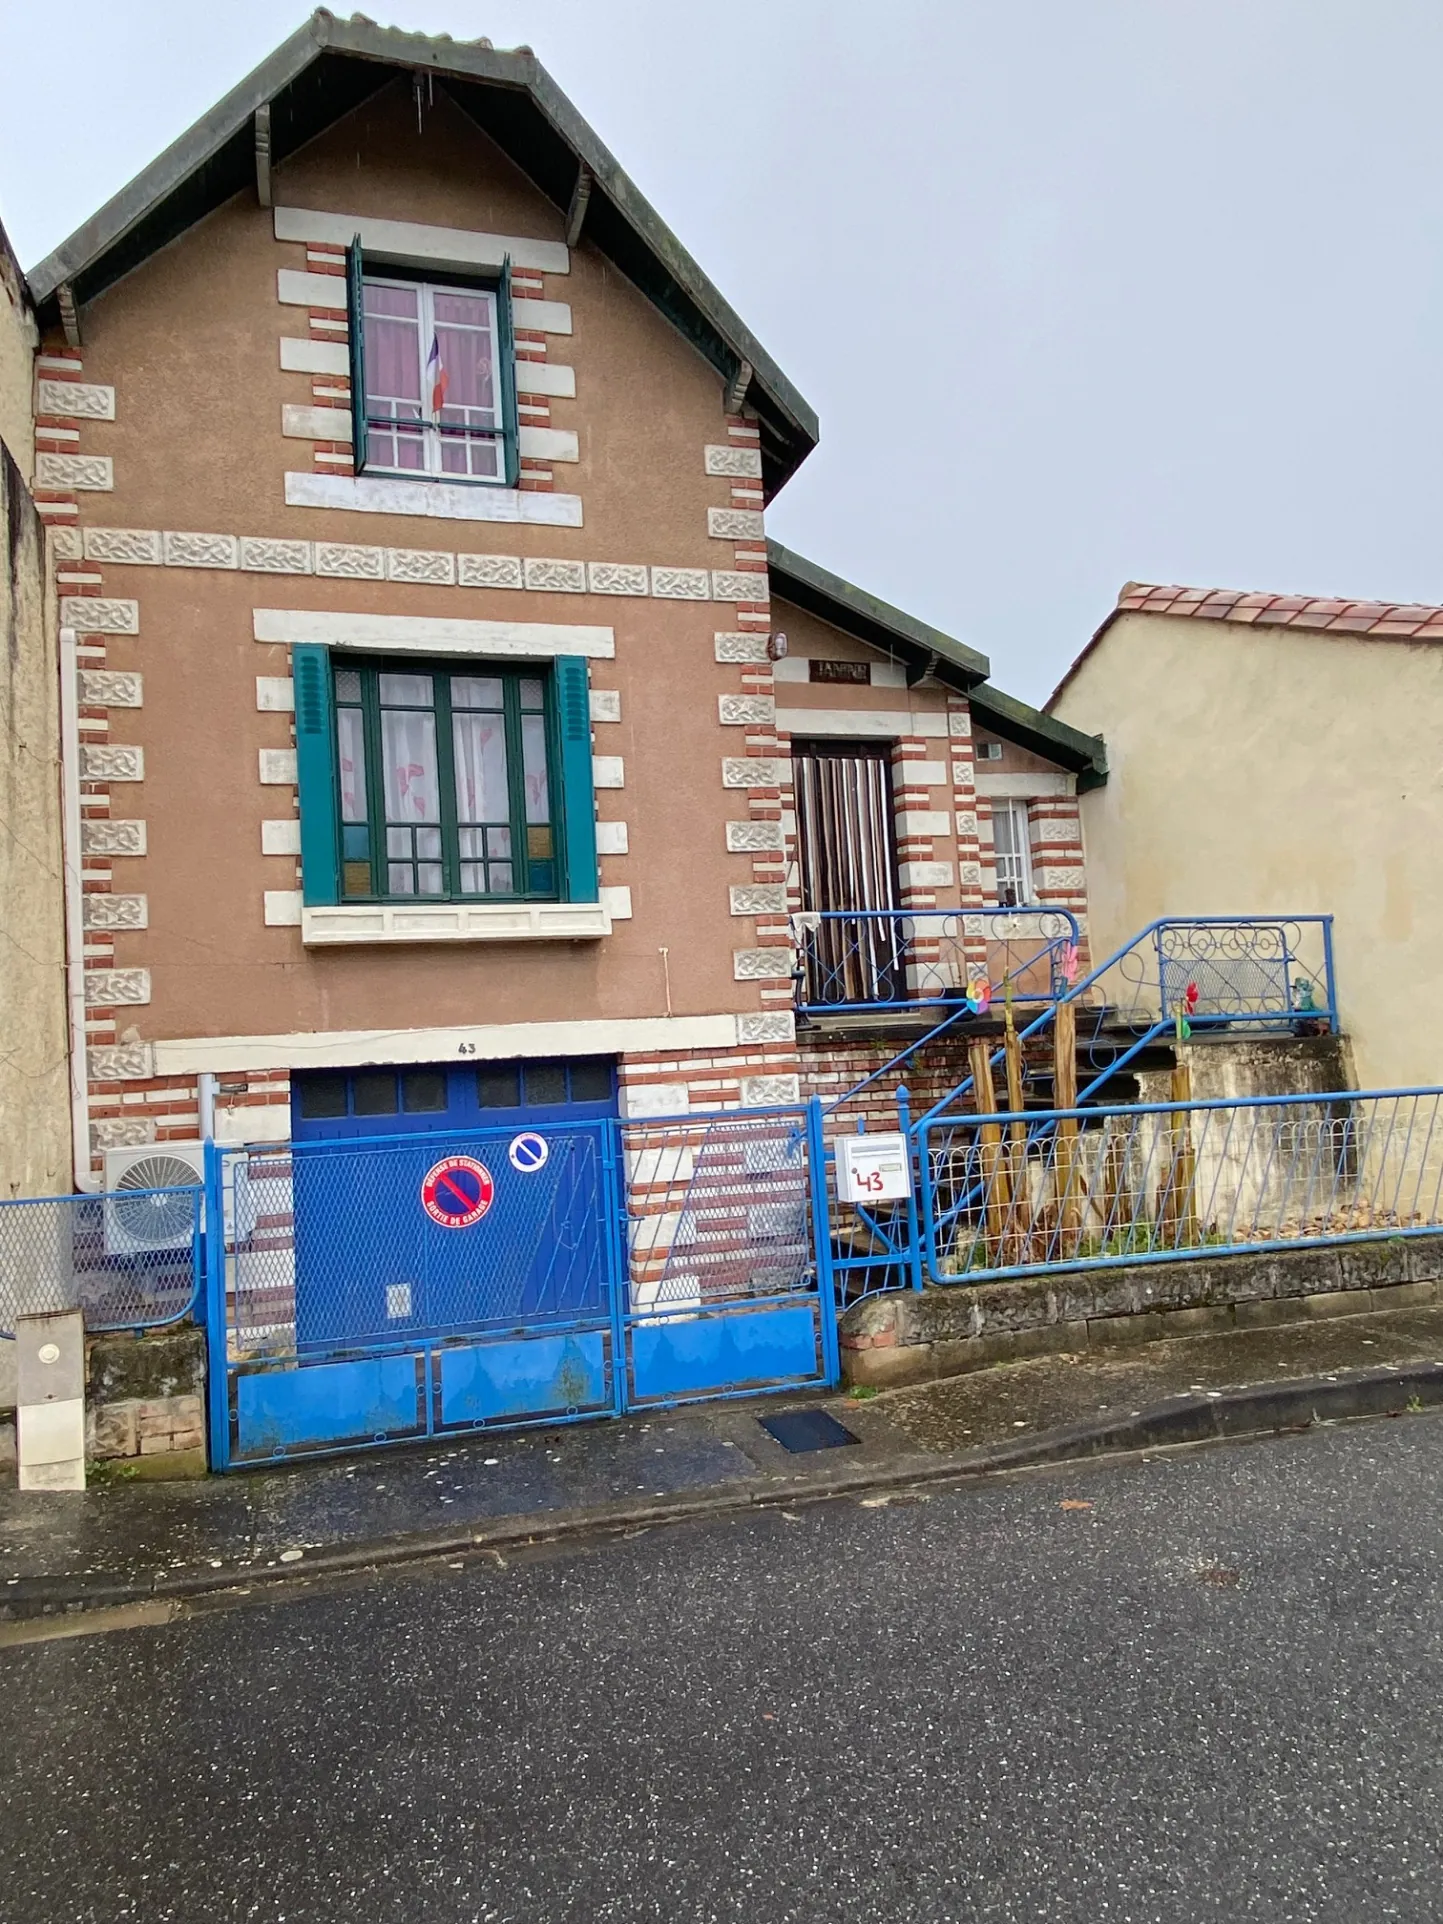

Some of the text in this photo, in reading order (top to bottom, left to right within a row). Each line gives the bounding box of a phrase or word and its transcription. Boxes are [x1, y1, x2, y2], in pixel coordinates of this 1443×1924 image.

[458, 1042, 476, 1055] 43
[448, 1159, 458, 1168] DE
[458, 1159, 490, 1186] STATIONNER
[856, 1171, 884, 1192] 43
[426, 1199, 489, 1225] SORTIE DE GARAGE
